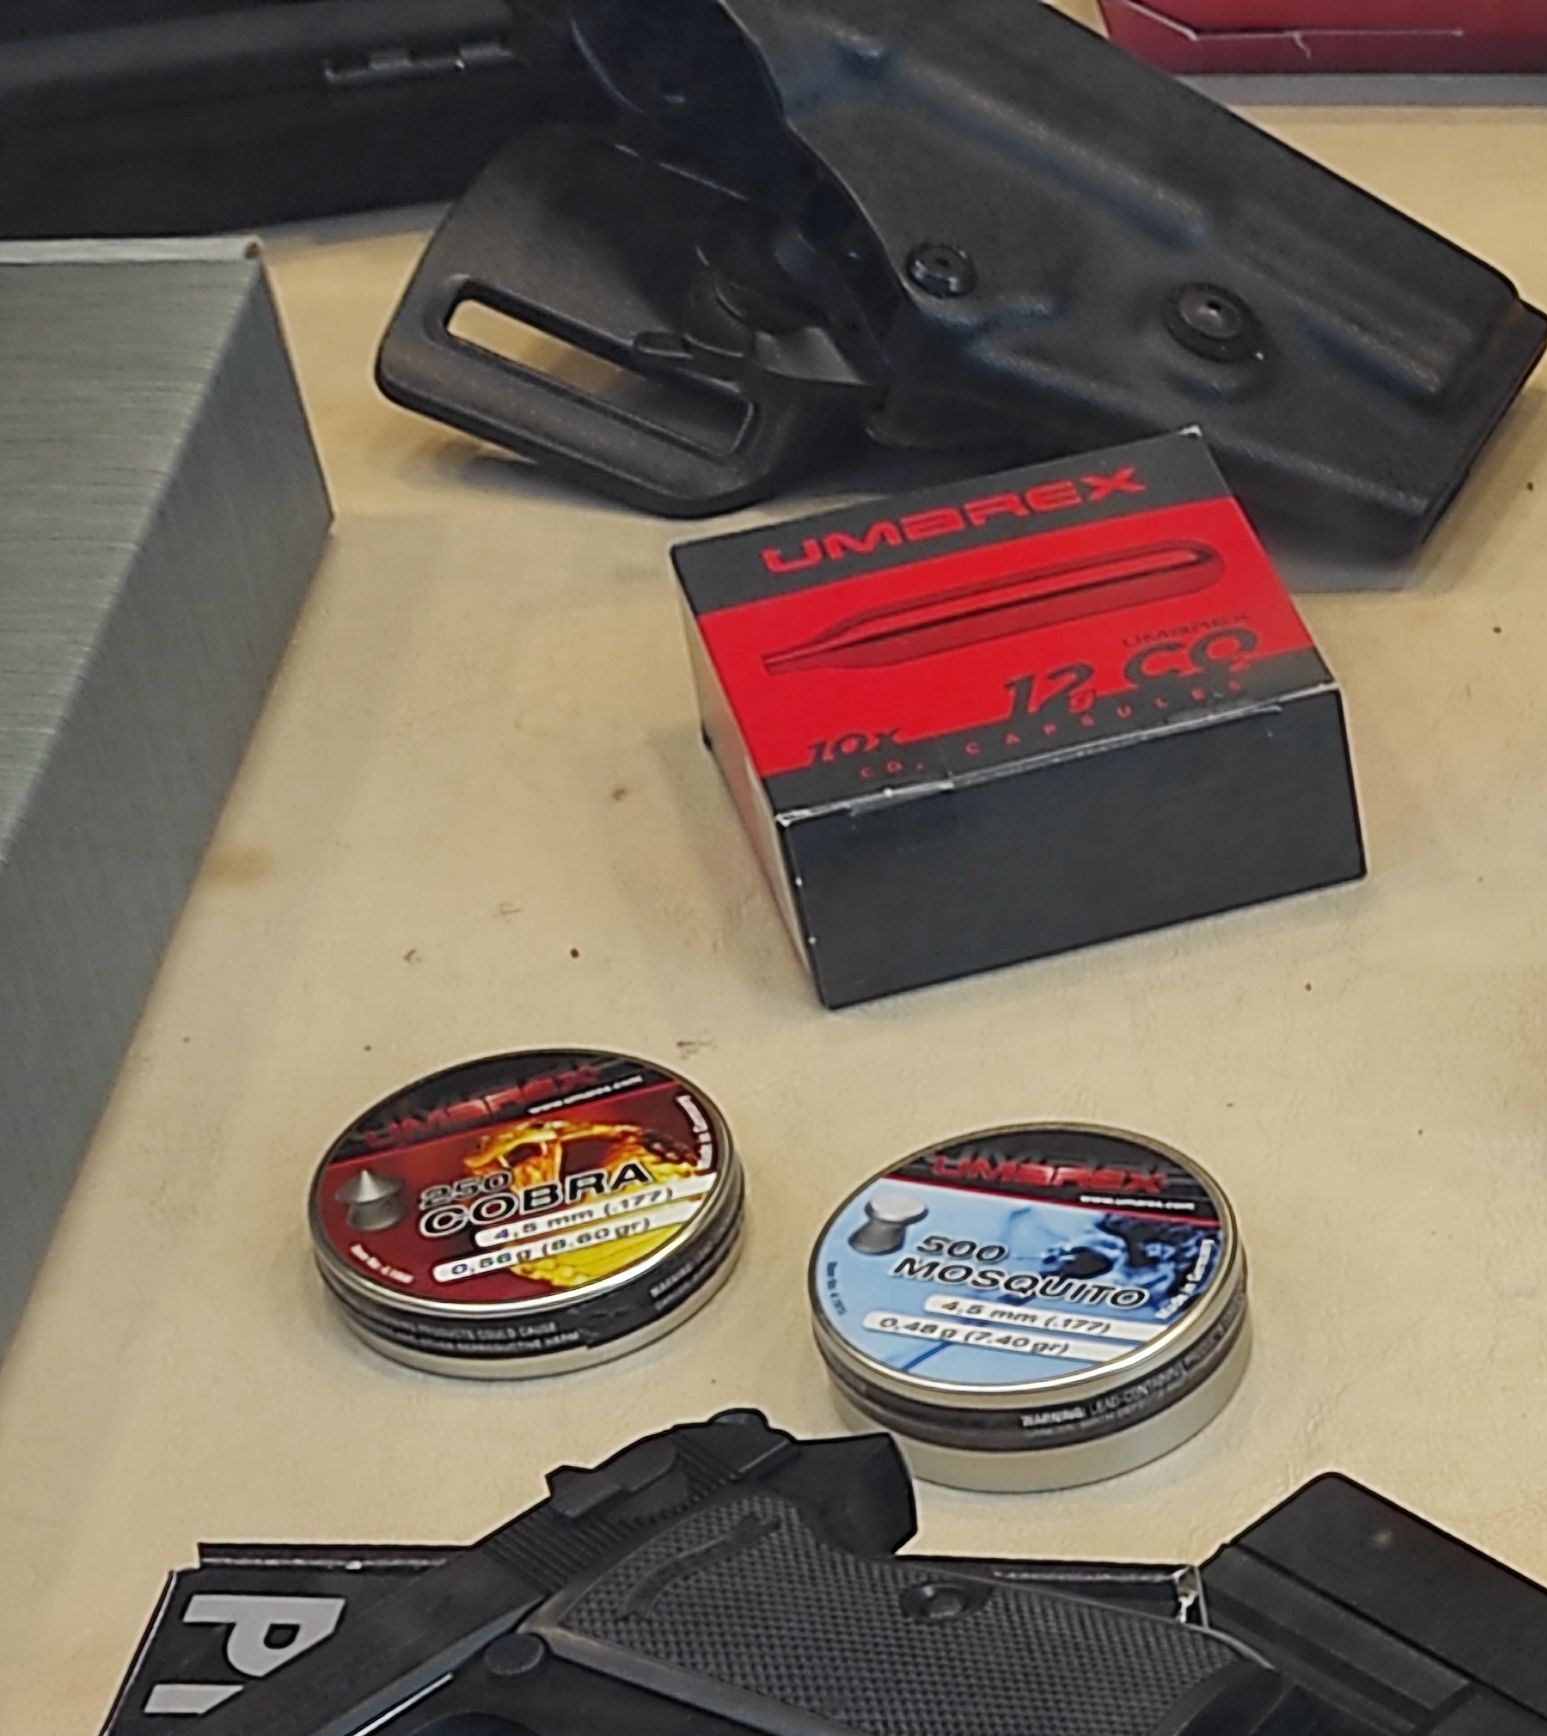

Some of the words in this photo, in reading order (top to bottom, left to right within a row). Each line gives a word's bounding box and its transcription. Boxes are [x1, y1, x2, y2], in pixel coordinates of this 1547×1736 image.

[761, 466, 1147, 574] UMAREX
[965, 678, 1242, 756] CAPSULES
[419, 1161, 654, 1239] COBRA
[420, 1170, 512, 1211] 250
[547, 1209, 593, 1228] mm
[916, 1234, 1010, 1264] 500
[889, 1255, 1150, 1311] MOSQUITO
[990, 1308, 1038, 1324] mm
[1044, 1314, 1111, 1335] (.177)
